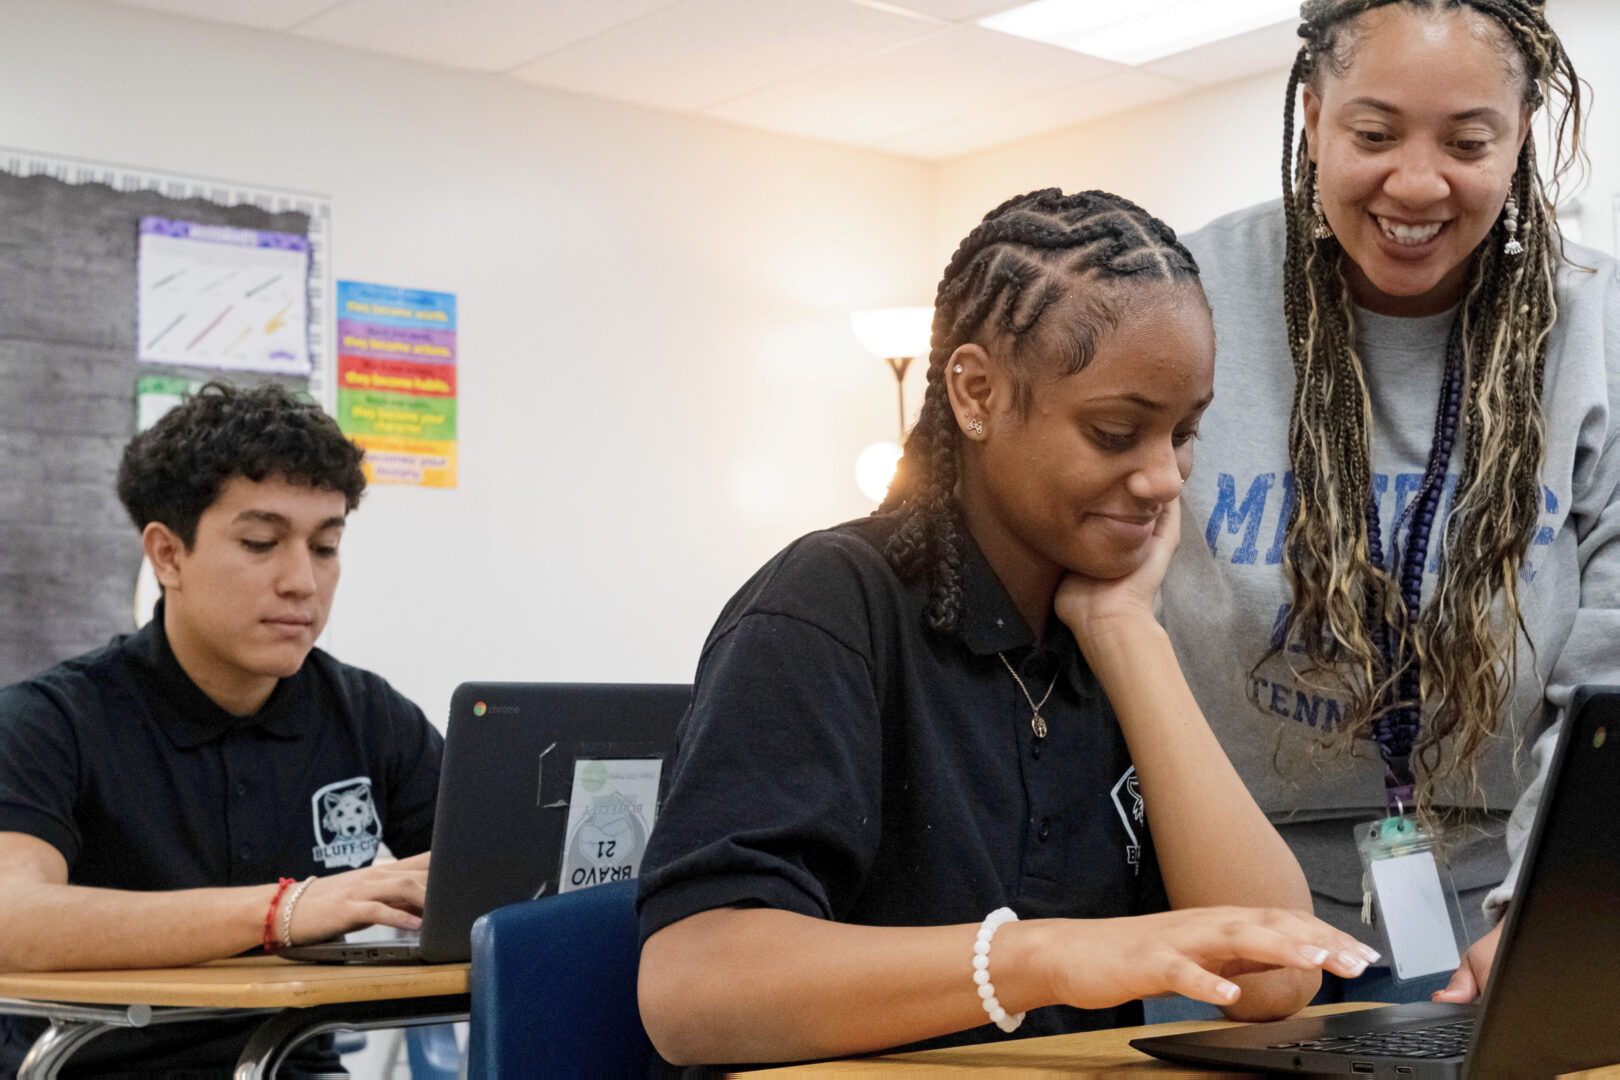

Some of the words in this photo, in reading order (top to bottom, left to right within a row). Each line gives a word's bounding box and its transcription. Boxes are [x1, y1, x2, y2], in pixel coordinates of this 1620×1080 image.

[488, 703, 521, 714] chrome
[598, 840, 616, 858] 21
[571, 865, 632, 885] BRAVO
